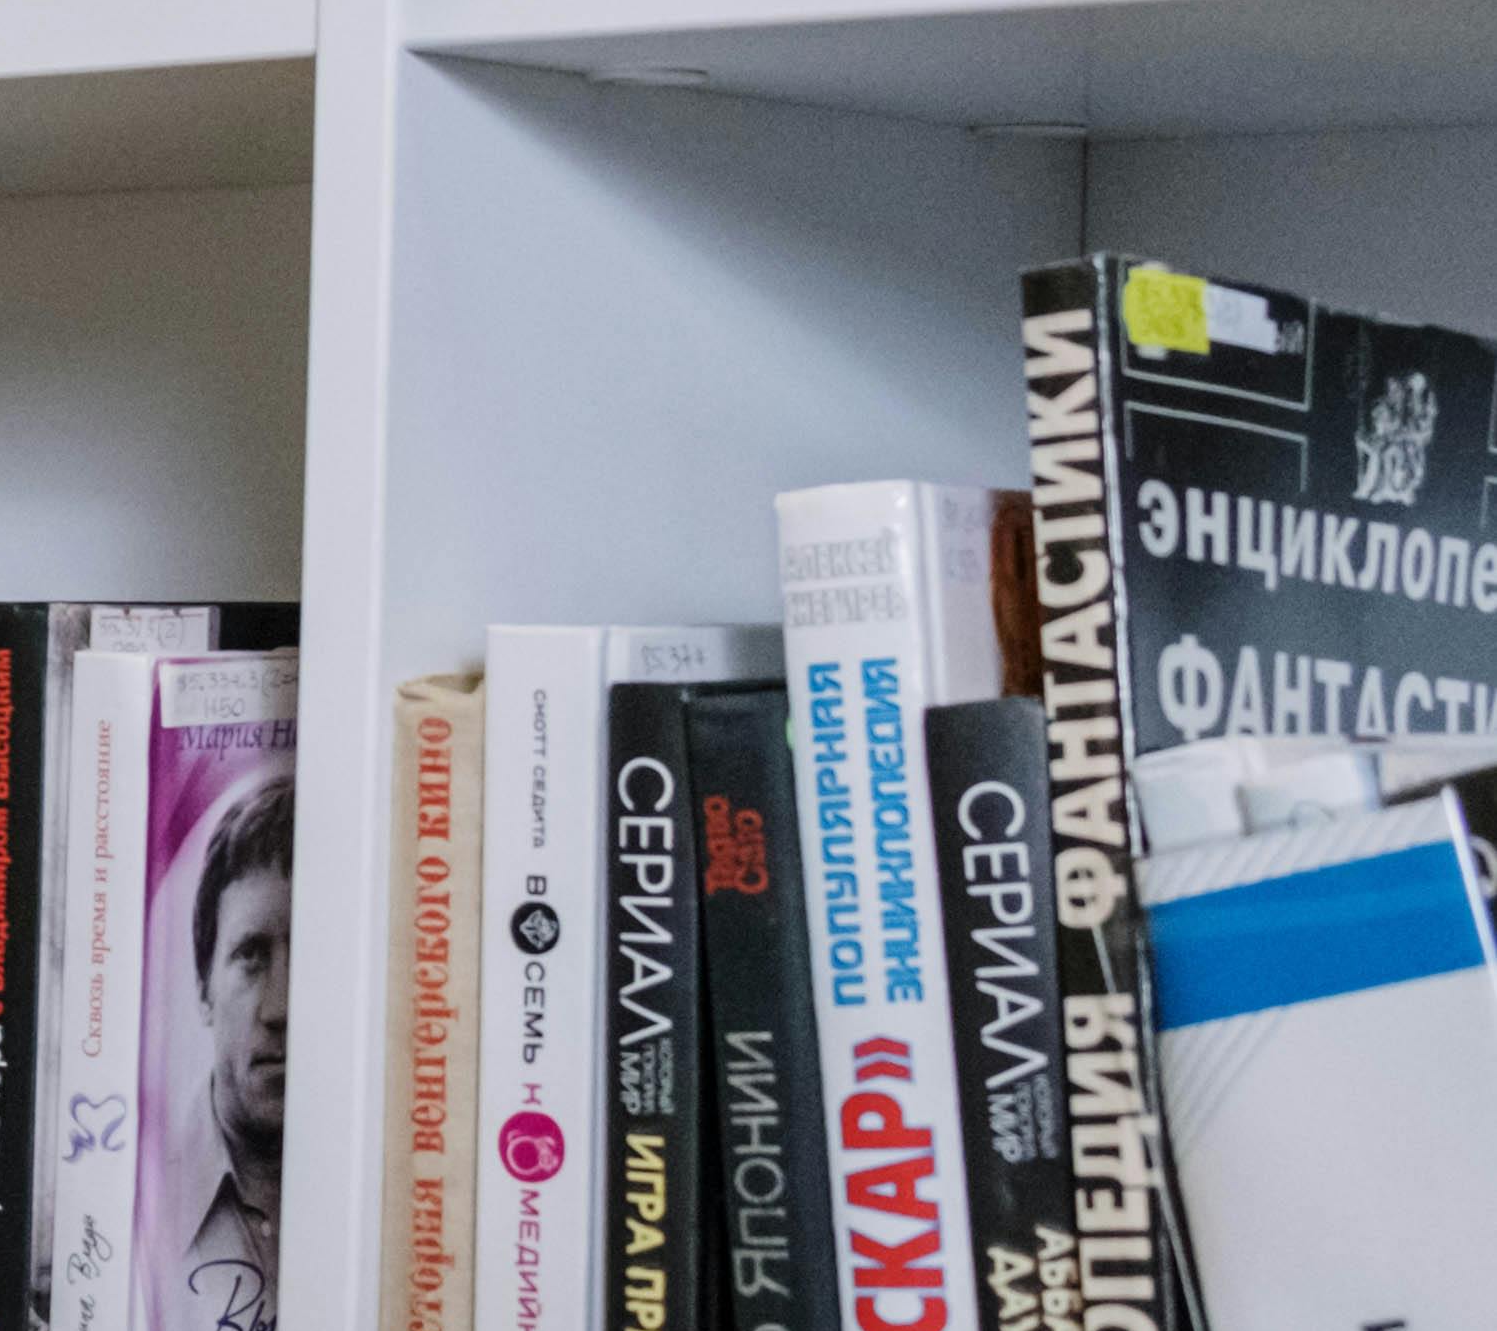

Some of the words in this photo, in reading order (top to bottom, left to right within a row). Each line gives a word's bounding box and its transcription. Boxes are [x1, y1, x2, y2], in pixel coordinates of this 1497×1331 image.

[1022, 309, 1128, 930] ФАНТАСТИКИ
[96, 719, 116, 860] расстояние
[179, 725, 263, 764] Мария
[417, 716, 452, 841] кино
[96, 868, 109, 883] и
[807, 662, 867, 1007] ПОПУЛЯРНАЯ
[861, 657, 924, 1004] ЭНЦИКЛОПЕДИЯ
[90, 889, 112, 963] время
[617, 756, 675, 1046] СЕРИАЛ
[81, 971, 104, 1059] Сквозь
[411, 855, 459, 1155] венгерского
[625, 1133, 666, 1256] ИГРА
